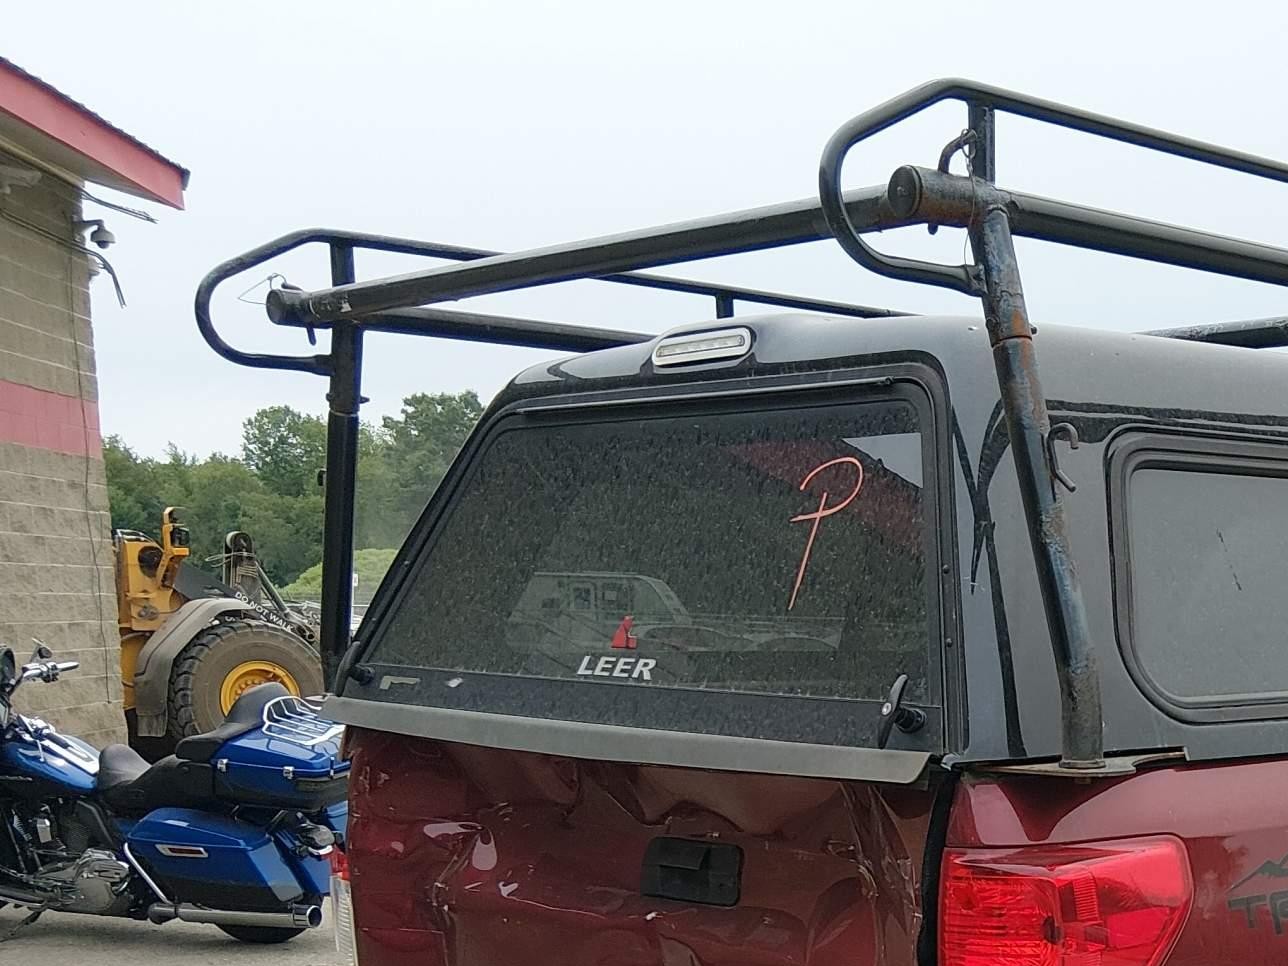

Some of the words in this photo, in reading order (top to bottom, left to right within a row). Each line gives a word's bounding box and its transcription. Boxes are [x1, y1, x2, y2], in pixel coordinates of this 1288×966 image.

[788, 456, 864, 611] P
[235, 591, 249, 603] DO
[249, 601, 270, 616] NOT
[269, 612, 294, 632] WALK
[577, 655, 657, 680] LEER
